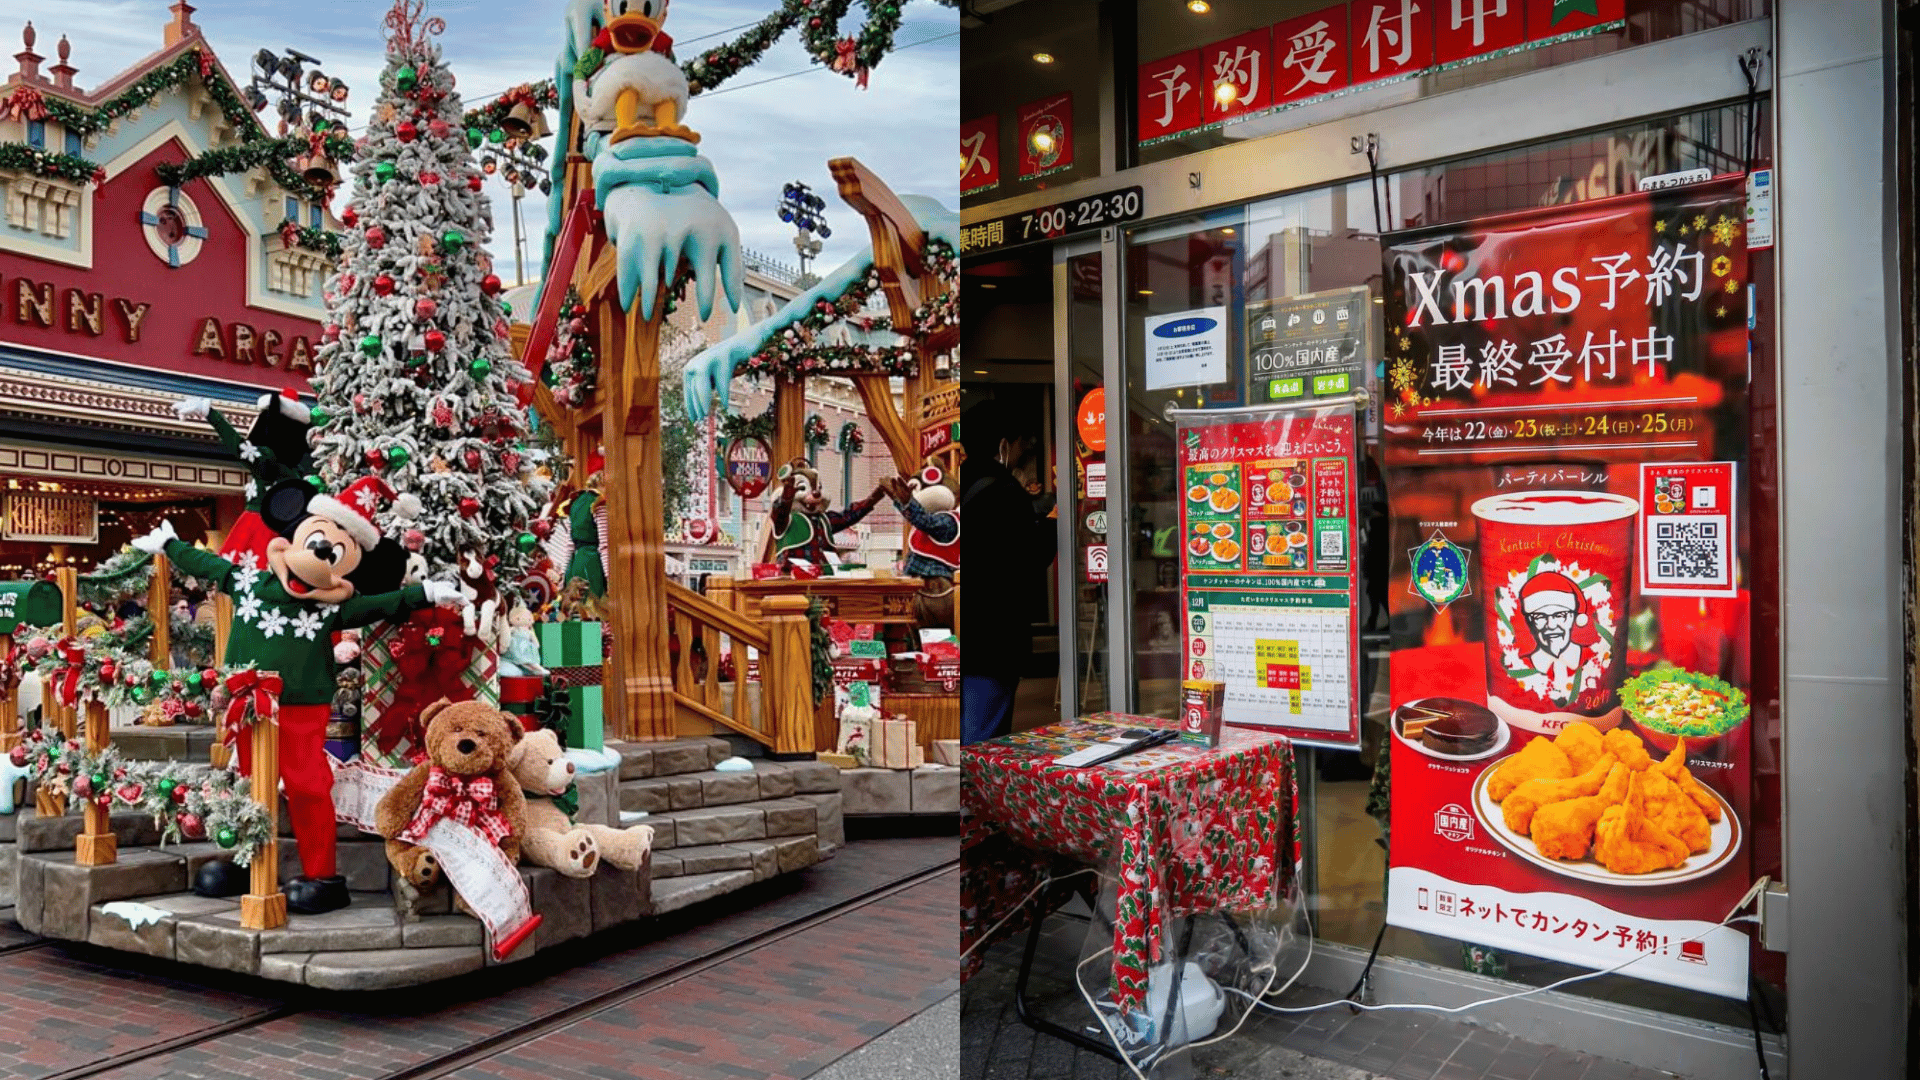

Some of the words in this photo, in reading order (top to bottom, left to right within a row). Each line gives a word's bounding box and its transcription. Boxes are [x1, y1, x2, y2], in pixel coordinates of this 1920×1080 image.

[1021, 207, 1066, 239] 7:00
[1077, 191, 1139, 226] 22:30
[0, 276, 151, 345] NNY
[1254, 345, 1340, 372] 100%国内産
[1430, 326, 1675, 391] 最終受付中
[1498, 469, 1609, 487] パーティバーレル
[1690, 759, 1735, 769] クリスマスサラダ
[1440, 814, 1468, 831] 国内産
[1460, 897, 1668, 956] ネットでカンタン予約!
